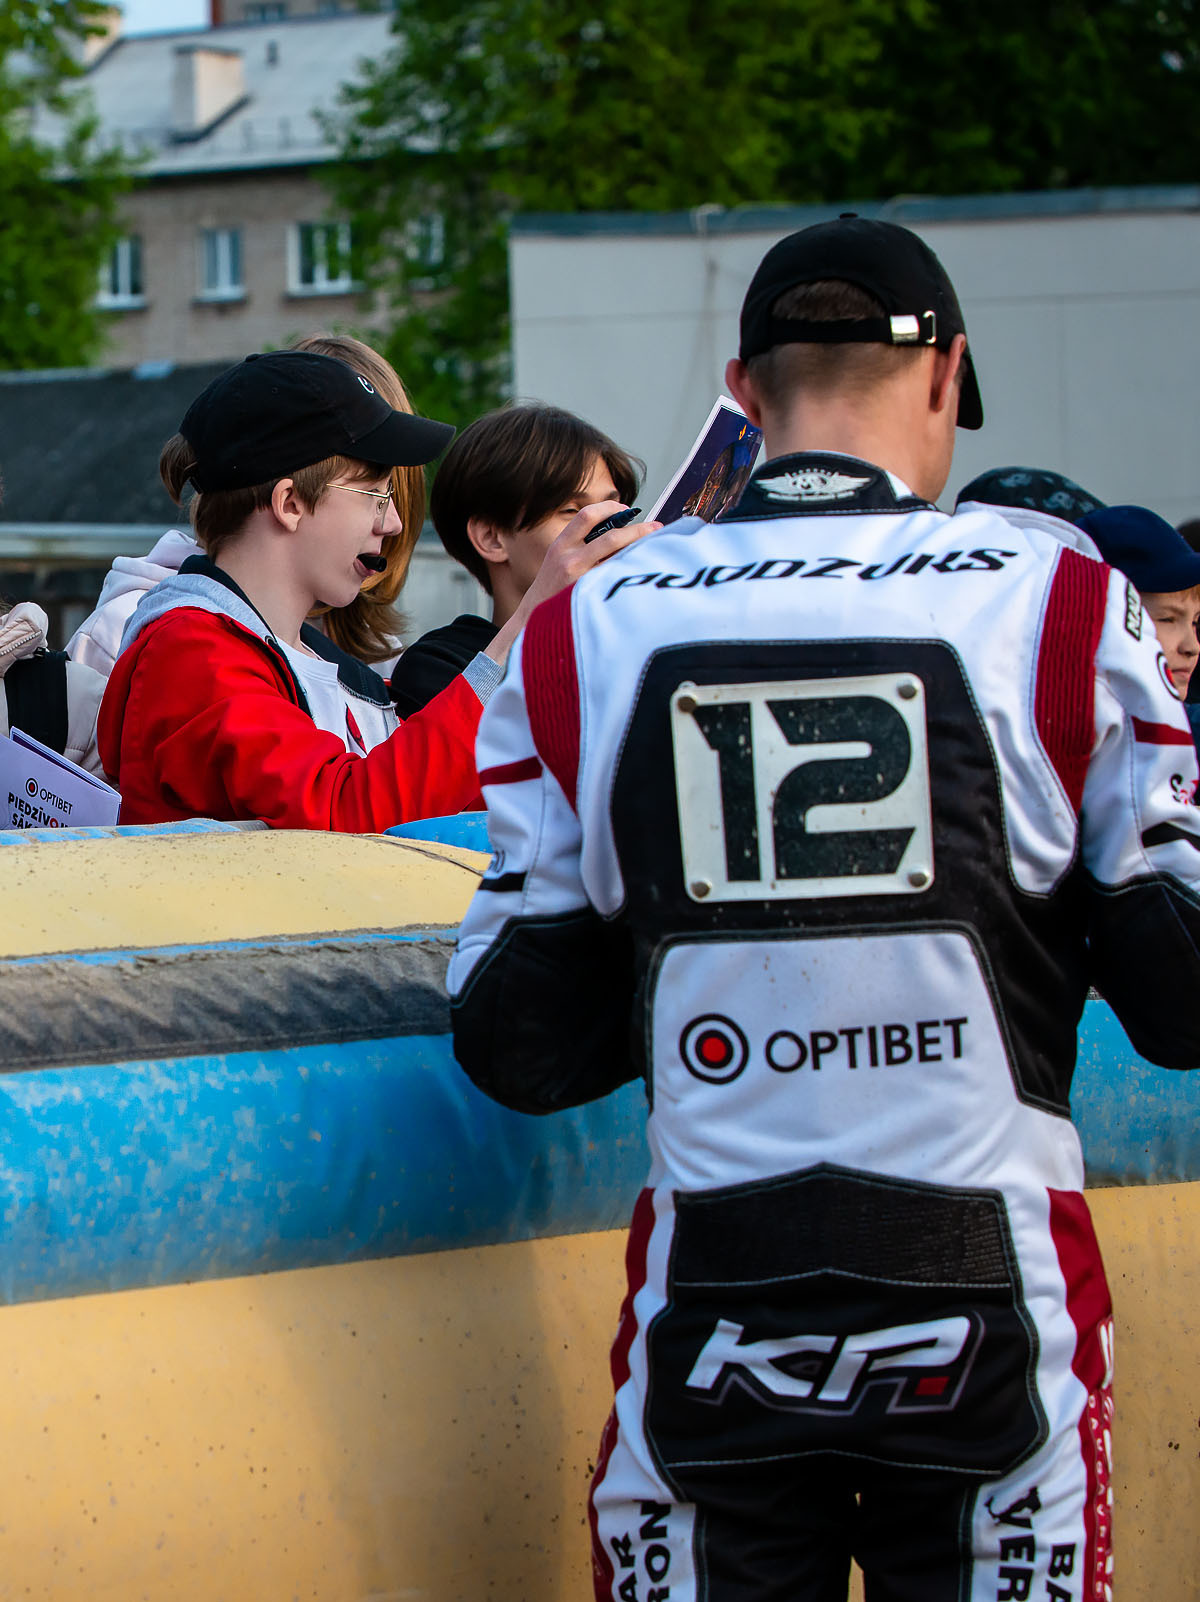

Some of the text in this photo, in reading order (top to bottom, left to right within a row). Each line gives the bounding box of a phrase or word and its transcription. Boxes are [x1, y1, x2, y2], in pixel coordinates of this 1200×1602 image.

[40, 788, 73, 816] OPTIBET
[691, 695, 917, 883] 12
[765, 1016, 968, 1073] OPTIBET
